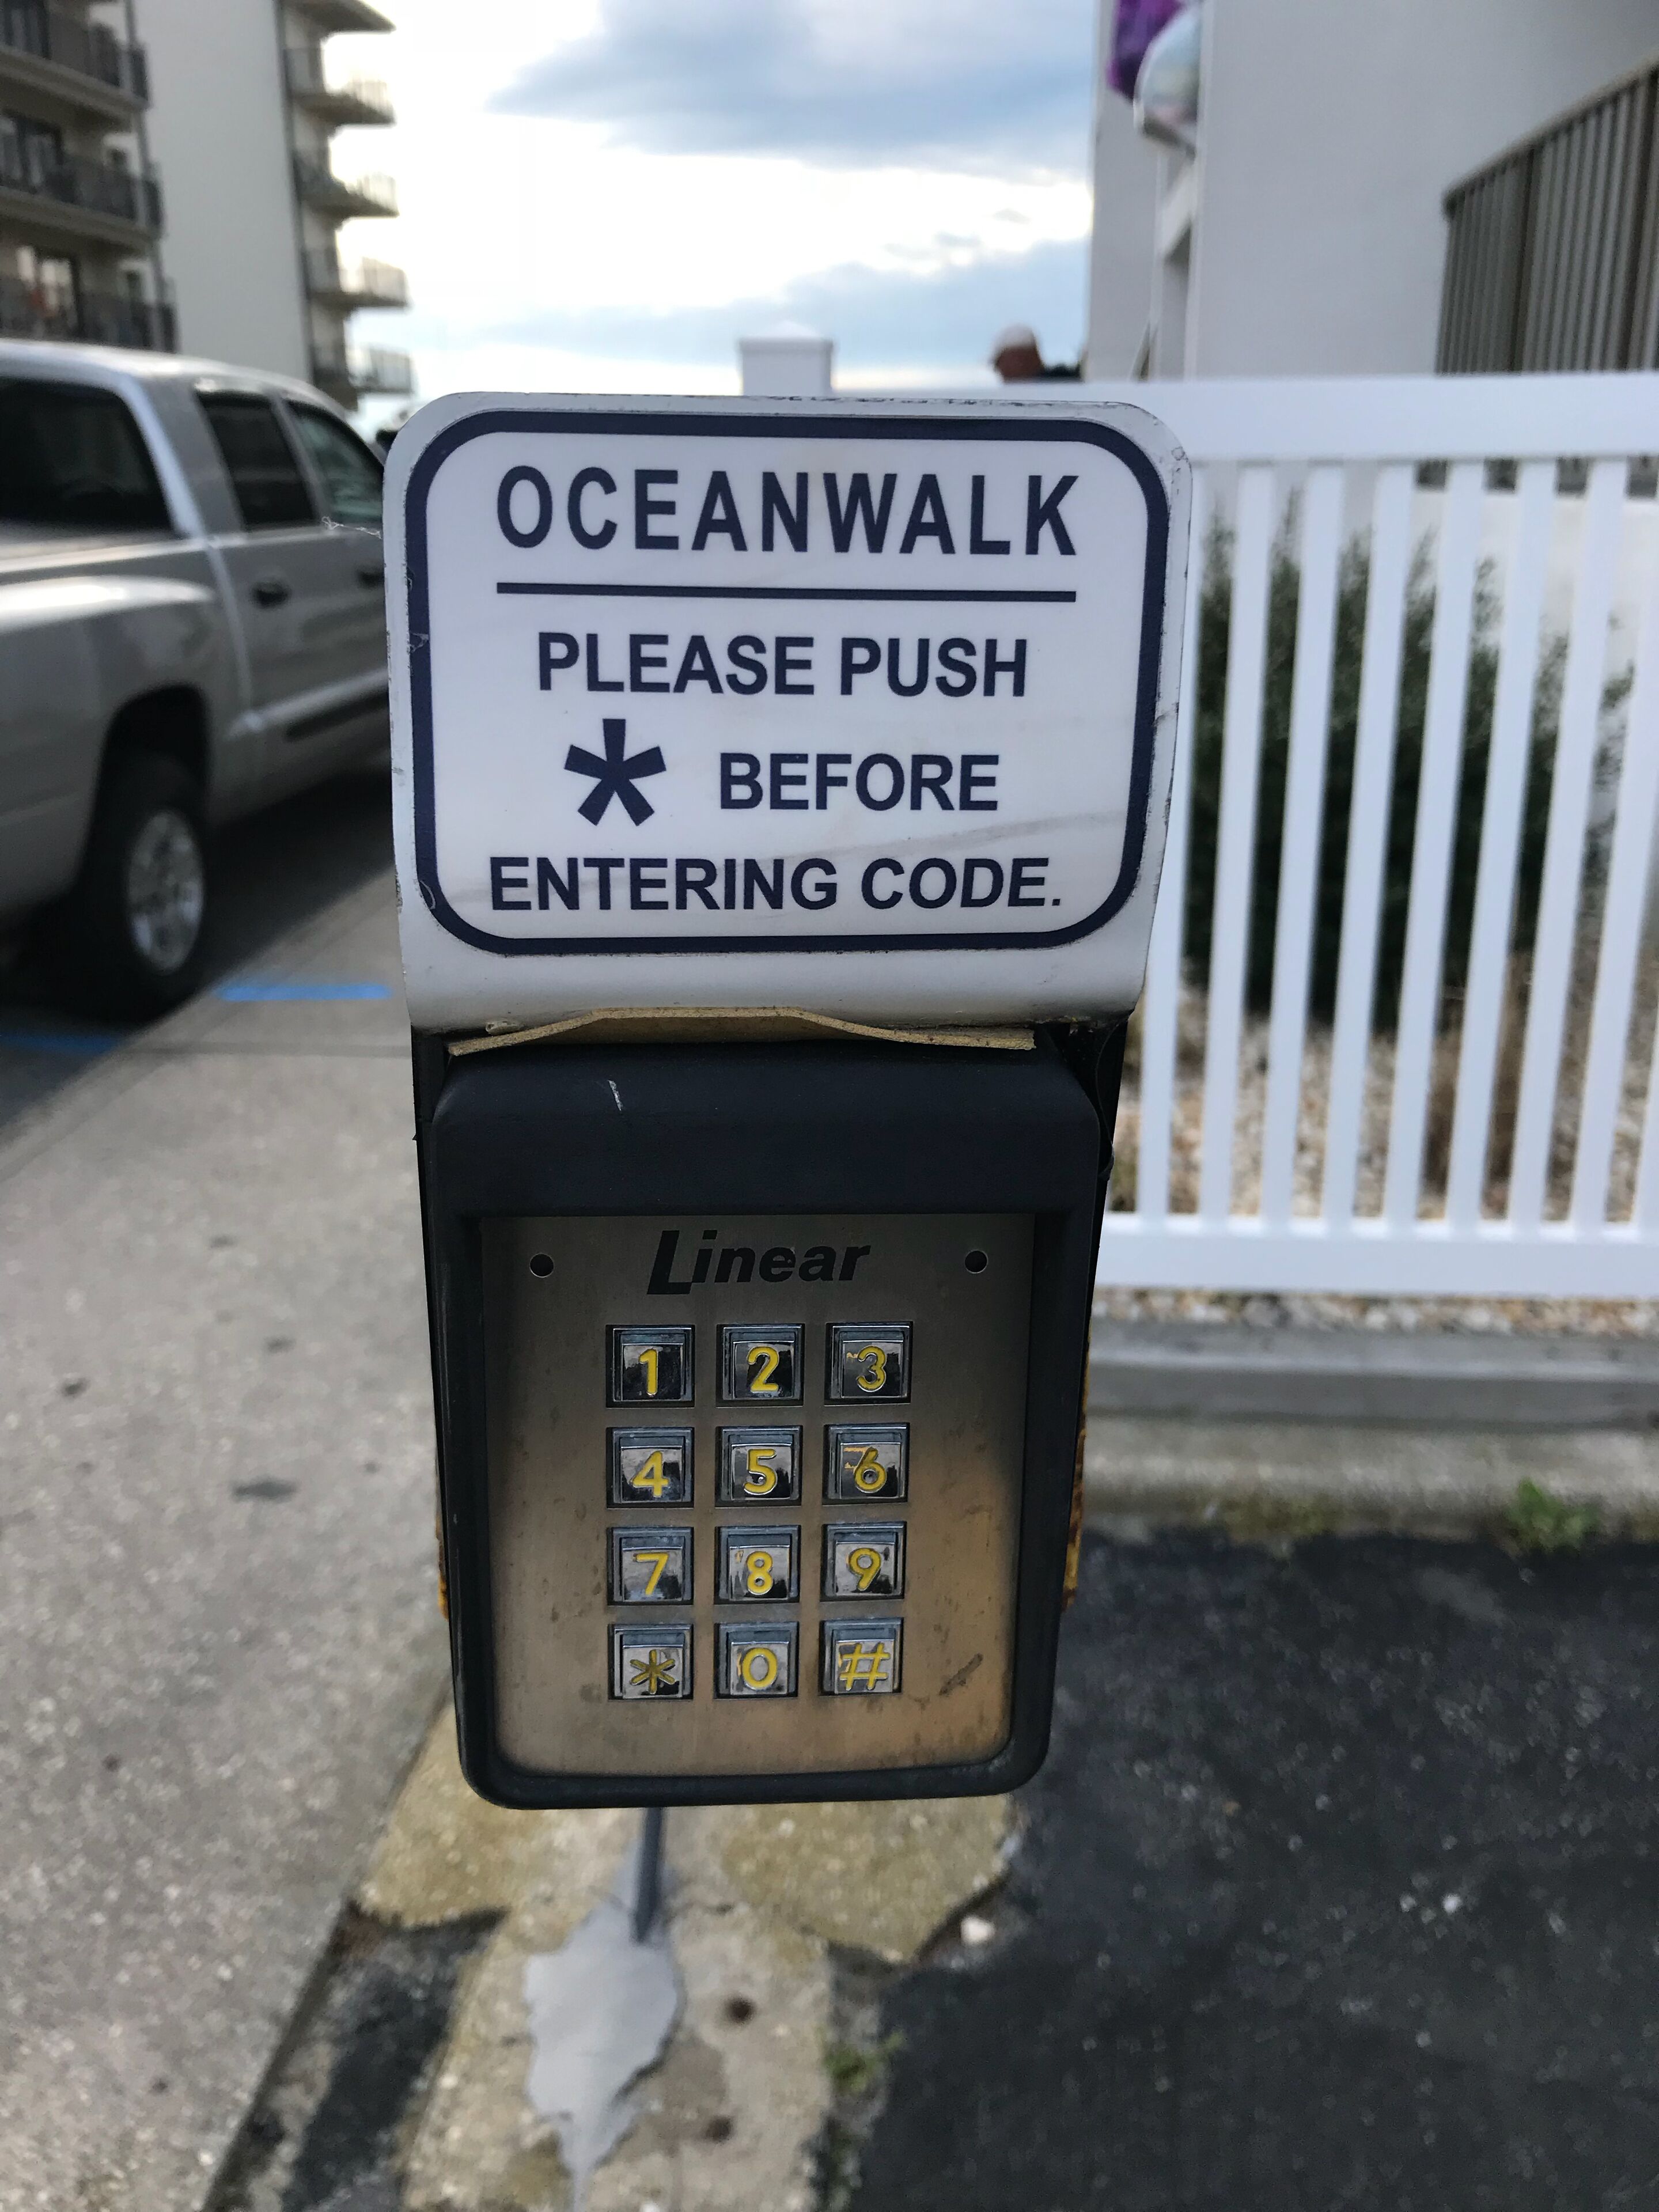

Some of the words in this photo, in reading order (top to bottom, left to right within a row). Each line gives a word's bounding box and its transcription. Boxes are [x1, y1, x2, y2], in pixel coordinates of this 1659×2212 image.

[497, 465, 1079, 556] OCEANWALK
[538, 631, 815, 695] PLEASE
[840, 637, 1027, 697] PUSH
[720, 752, 999, 812] BEFORE
[490, 857, 838, 911] ENTERING
[861, 857, 1061, 910] CODE.
[646, 1230, 870, 1296] Linear
[639, 1349, 658, 1396] 1
[747, 1346, 779, 1393] 2
[857, 1346, 887, 1391] 3
[631, 1451, 669, 1497] 4
[743, 1449, 777, 1495] 5
[853, 1446, 888, 1493] 6
[634, 1554, 669, 1597] 7
[746, 1551, 774, 1595] 8
[851, 1548, 882, 1591] 9
[742, 1647, 778, 1690] 0
